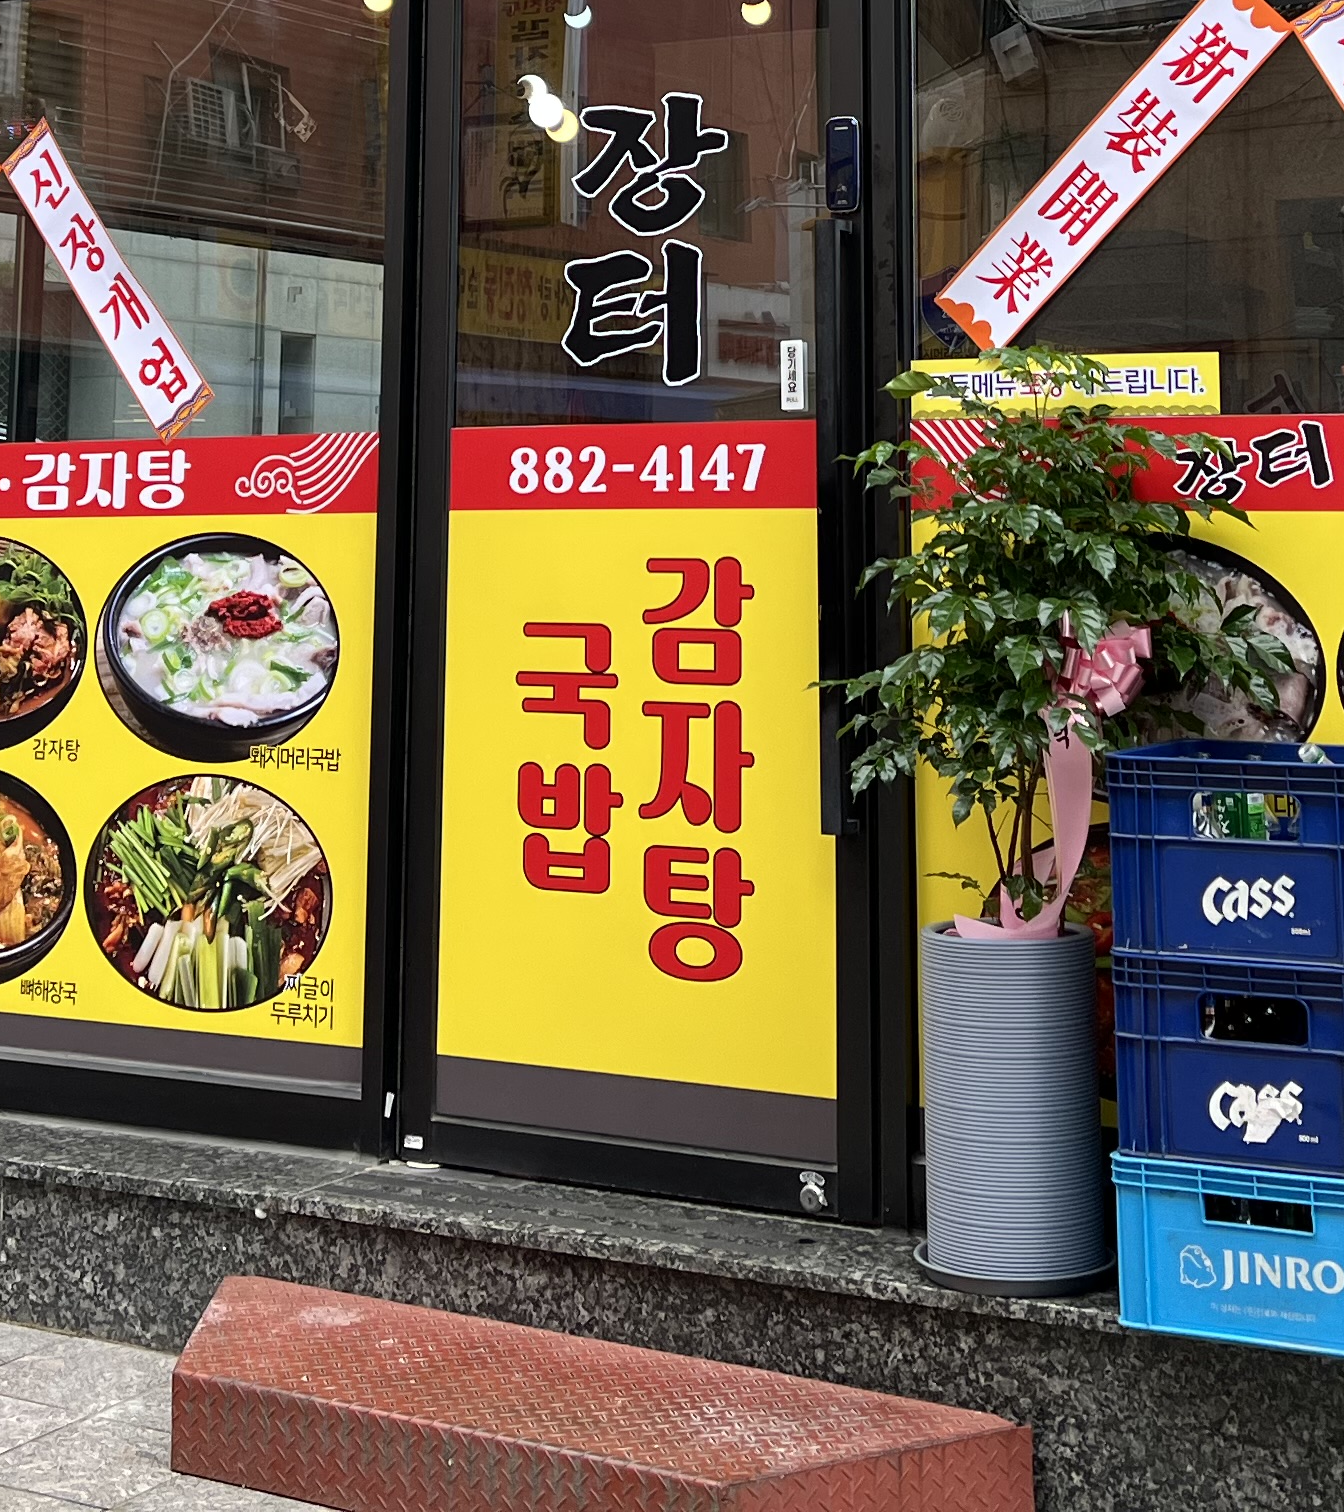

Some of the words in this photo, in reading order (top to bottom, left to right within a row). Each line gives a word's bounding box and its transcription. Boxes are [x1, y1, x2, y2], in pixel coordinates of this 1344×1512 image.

[975, 20, 1251, 315] 新裝開業
[561, 91, 729, 387] 장터
[29, 148, 190, 405] 신장개업
[786, 345, 798, 393] 당기세요
[508, 442, 767, 495] 882-4147
[1173, 420, 1334, 505] 장터
[31, 736, 81, 764] 감자탕
[250, 743, 341, 773] 돼지머리국밥
[516, 621, 624, 895] 국밥
[638, 555, 755, 982] 감자탕
[1201, 873, 1297, 927] Cass
[20, 978, 79, 1006] 뼈해장국
[284, 972, 336, 1001] 짜글이
[270, 1000, 335, 1030] 두루치기
